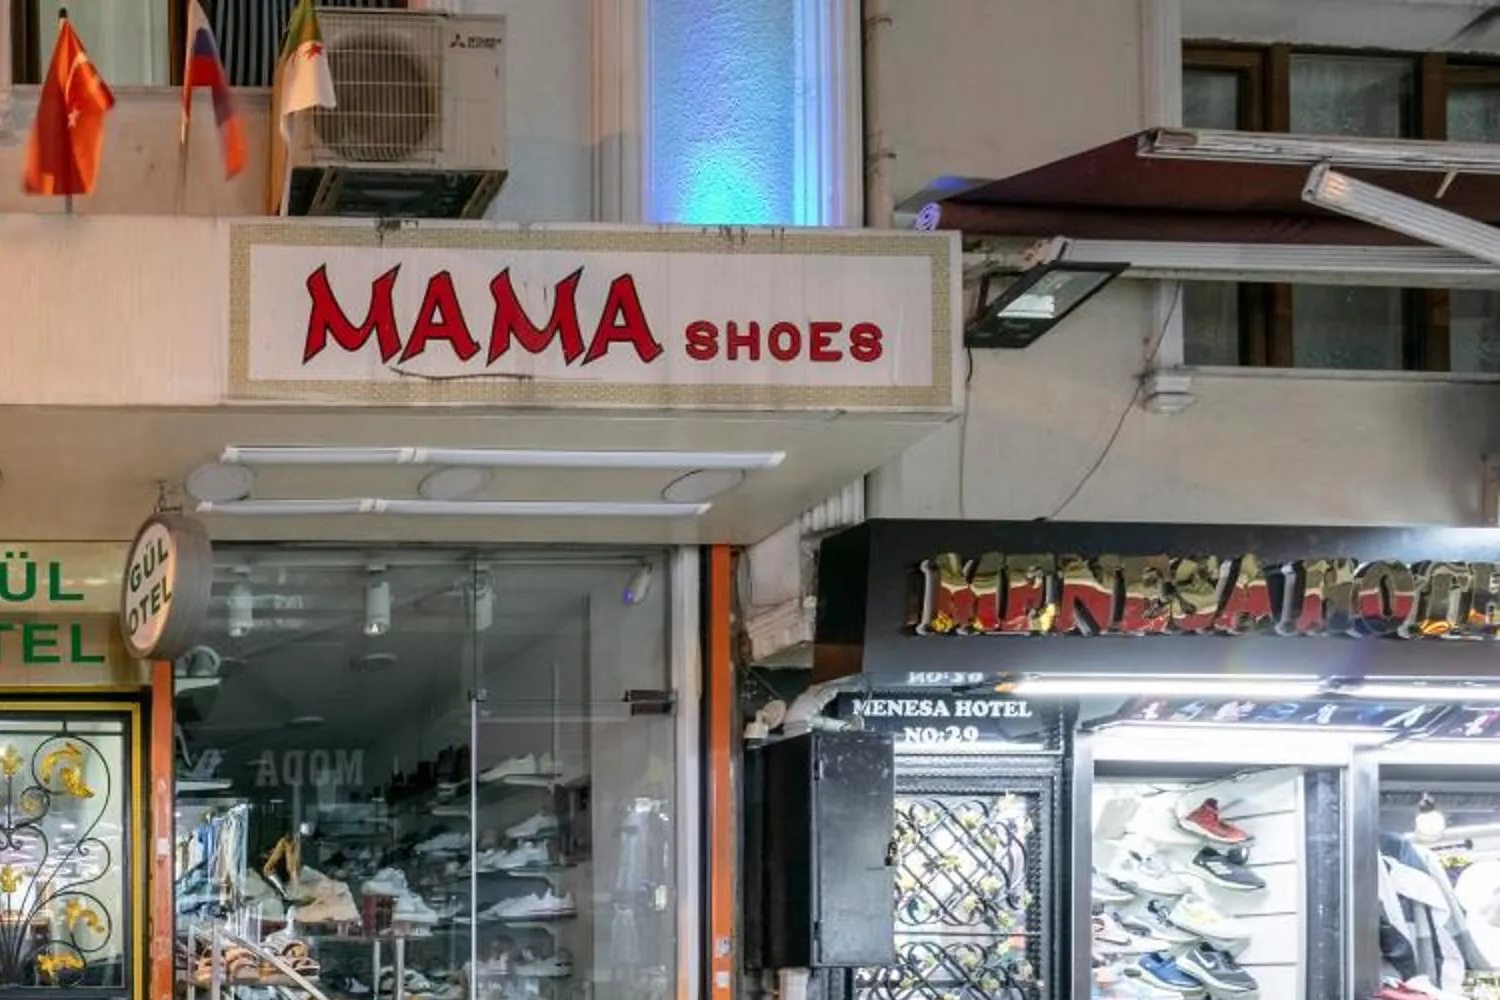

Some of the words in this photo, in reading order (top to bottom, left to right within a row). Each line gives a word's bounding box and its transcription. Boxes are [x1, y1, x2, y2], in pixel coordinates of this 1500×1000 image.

[302, 263, 663, 367] MAMA
[684, 320, 884, 362] SHOES
[130, 537, 168, 593] GÜL
[128, 575, 172, 636] OTEL
[852, 700, 950, 718] MENESA
[954, 700, 1033, 718] HOTEL
[904, 726, 980, 744] NO:29
